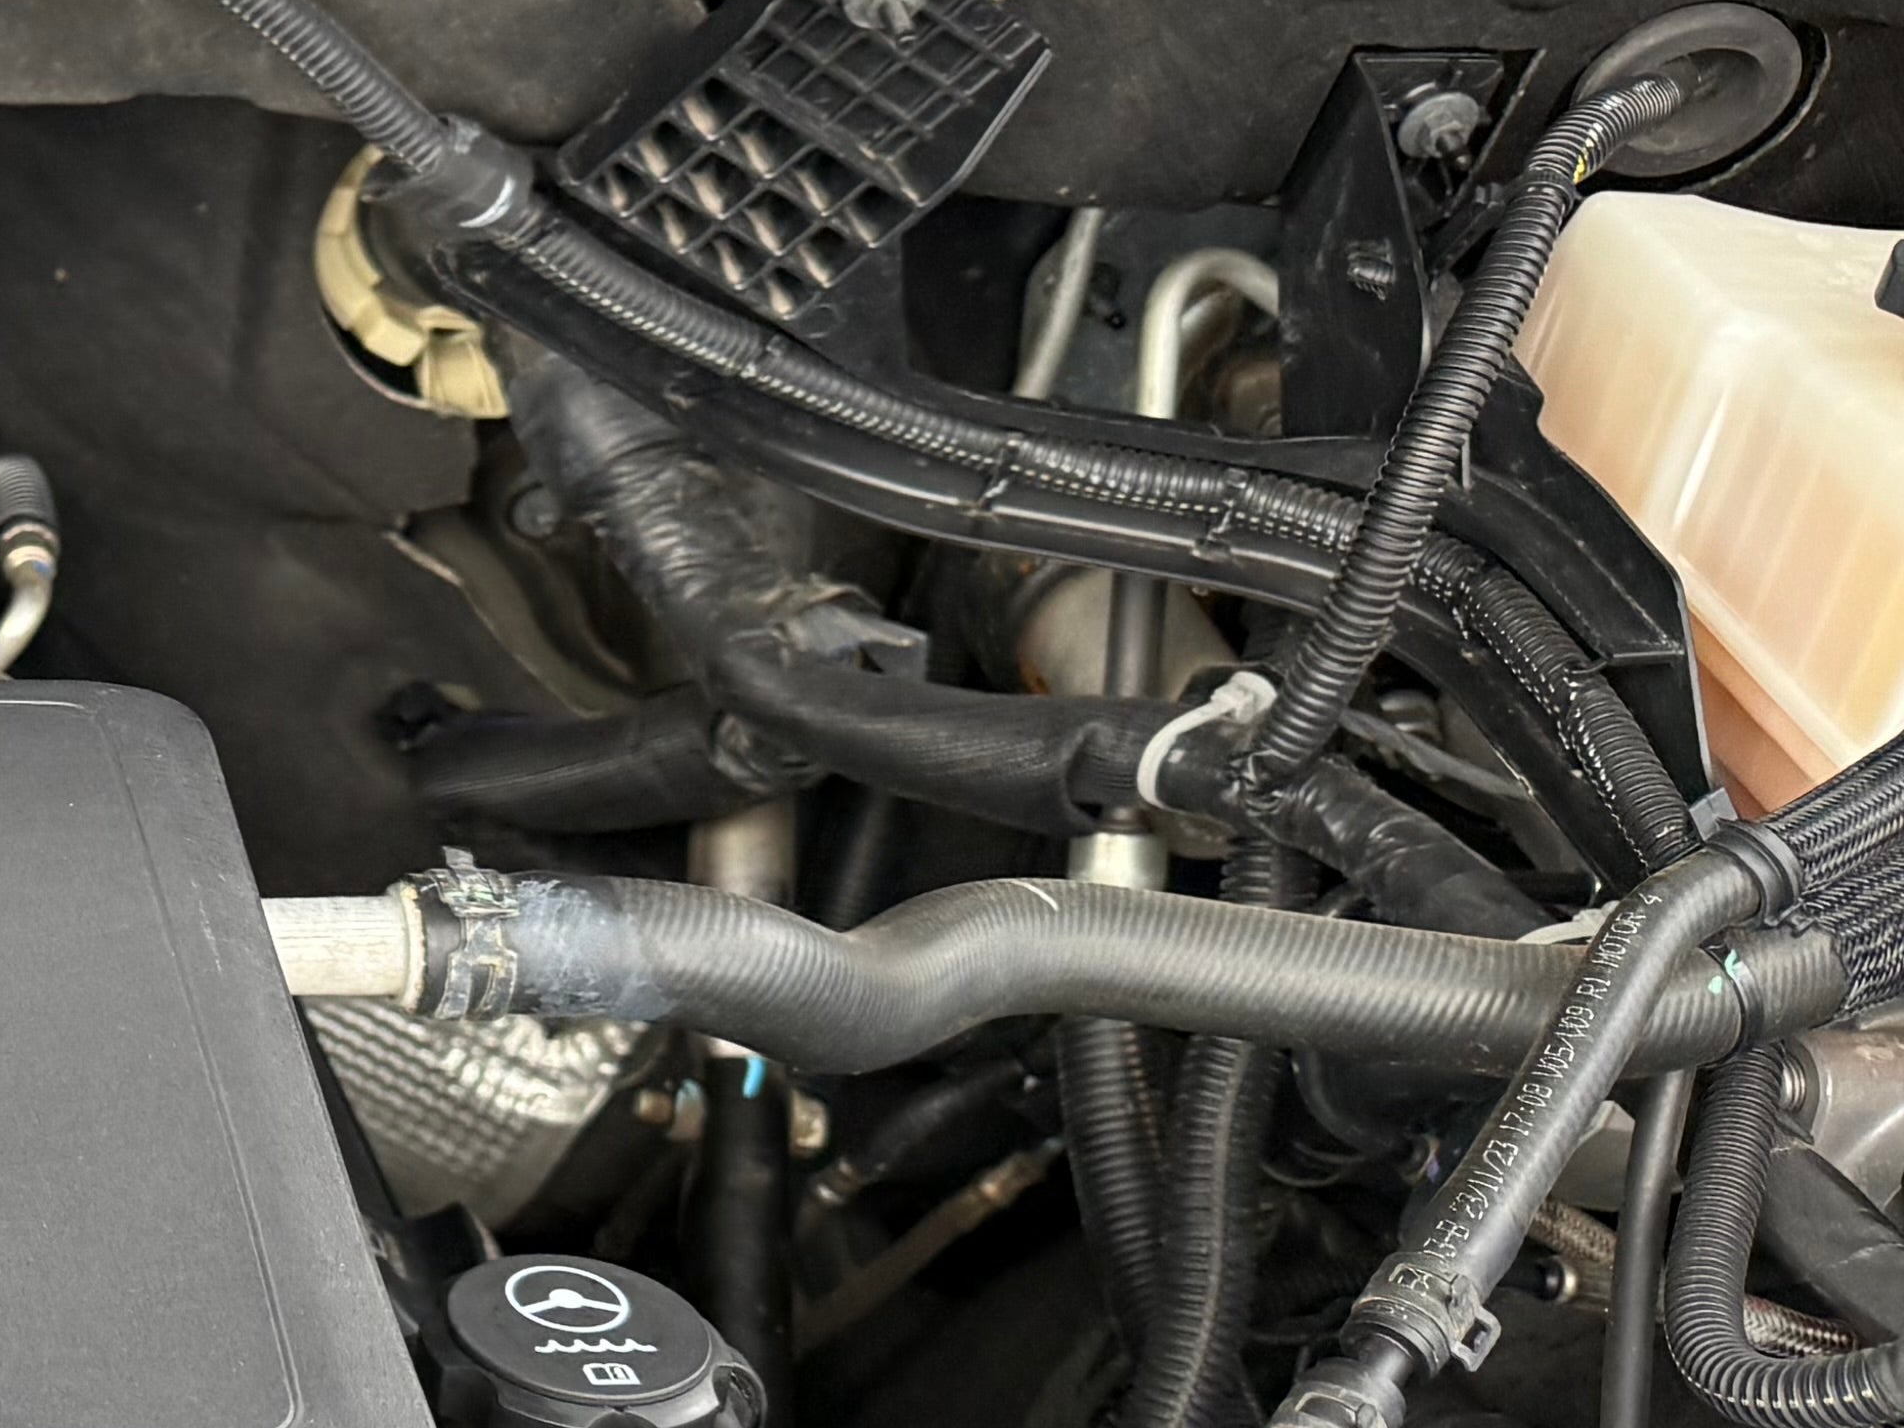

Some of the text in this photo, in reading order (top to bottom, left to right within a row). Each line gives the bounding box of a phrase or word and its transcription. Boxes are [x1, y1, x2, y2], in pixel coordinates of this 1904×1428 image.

[1449, 1139, 1519, 1220] 23/11/23
[1499, 1083, 1552, 1136] 17:08
[1592, 911, 1646, 968] MOTOR
